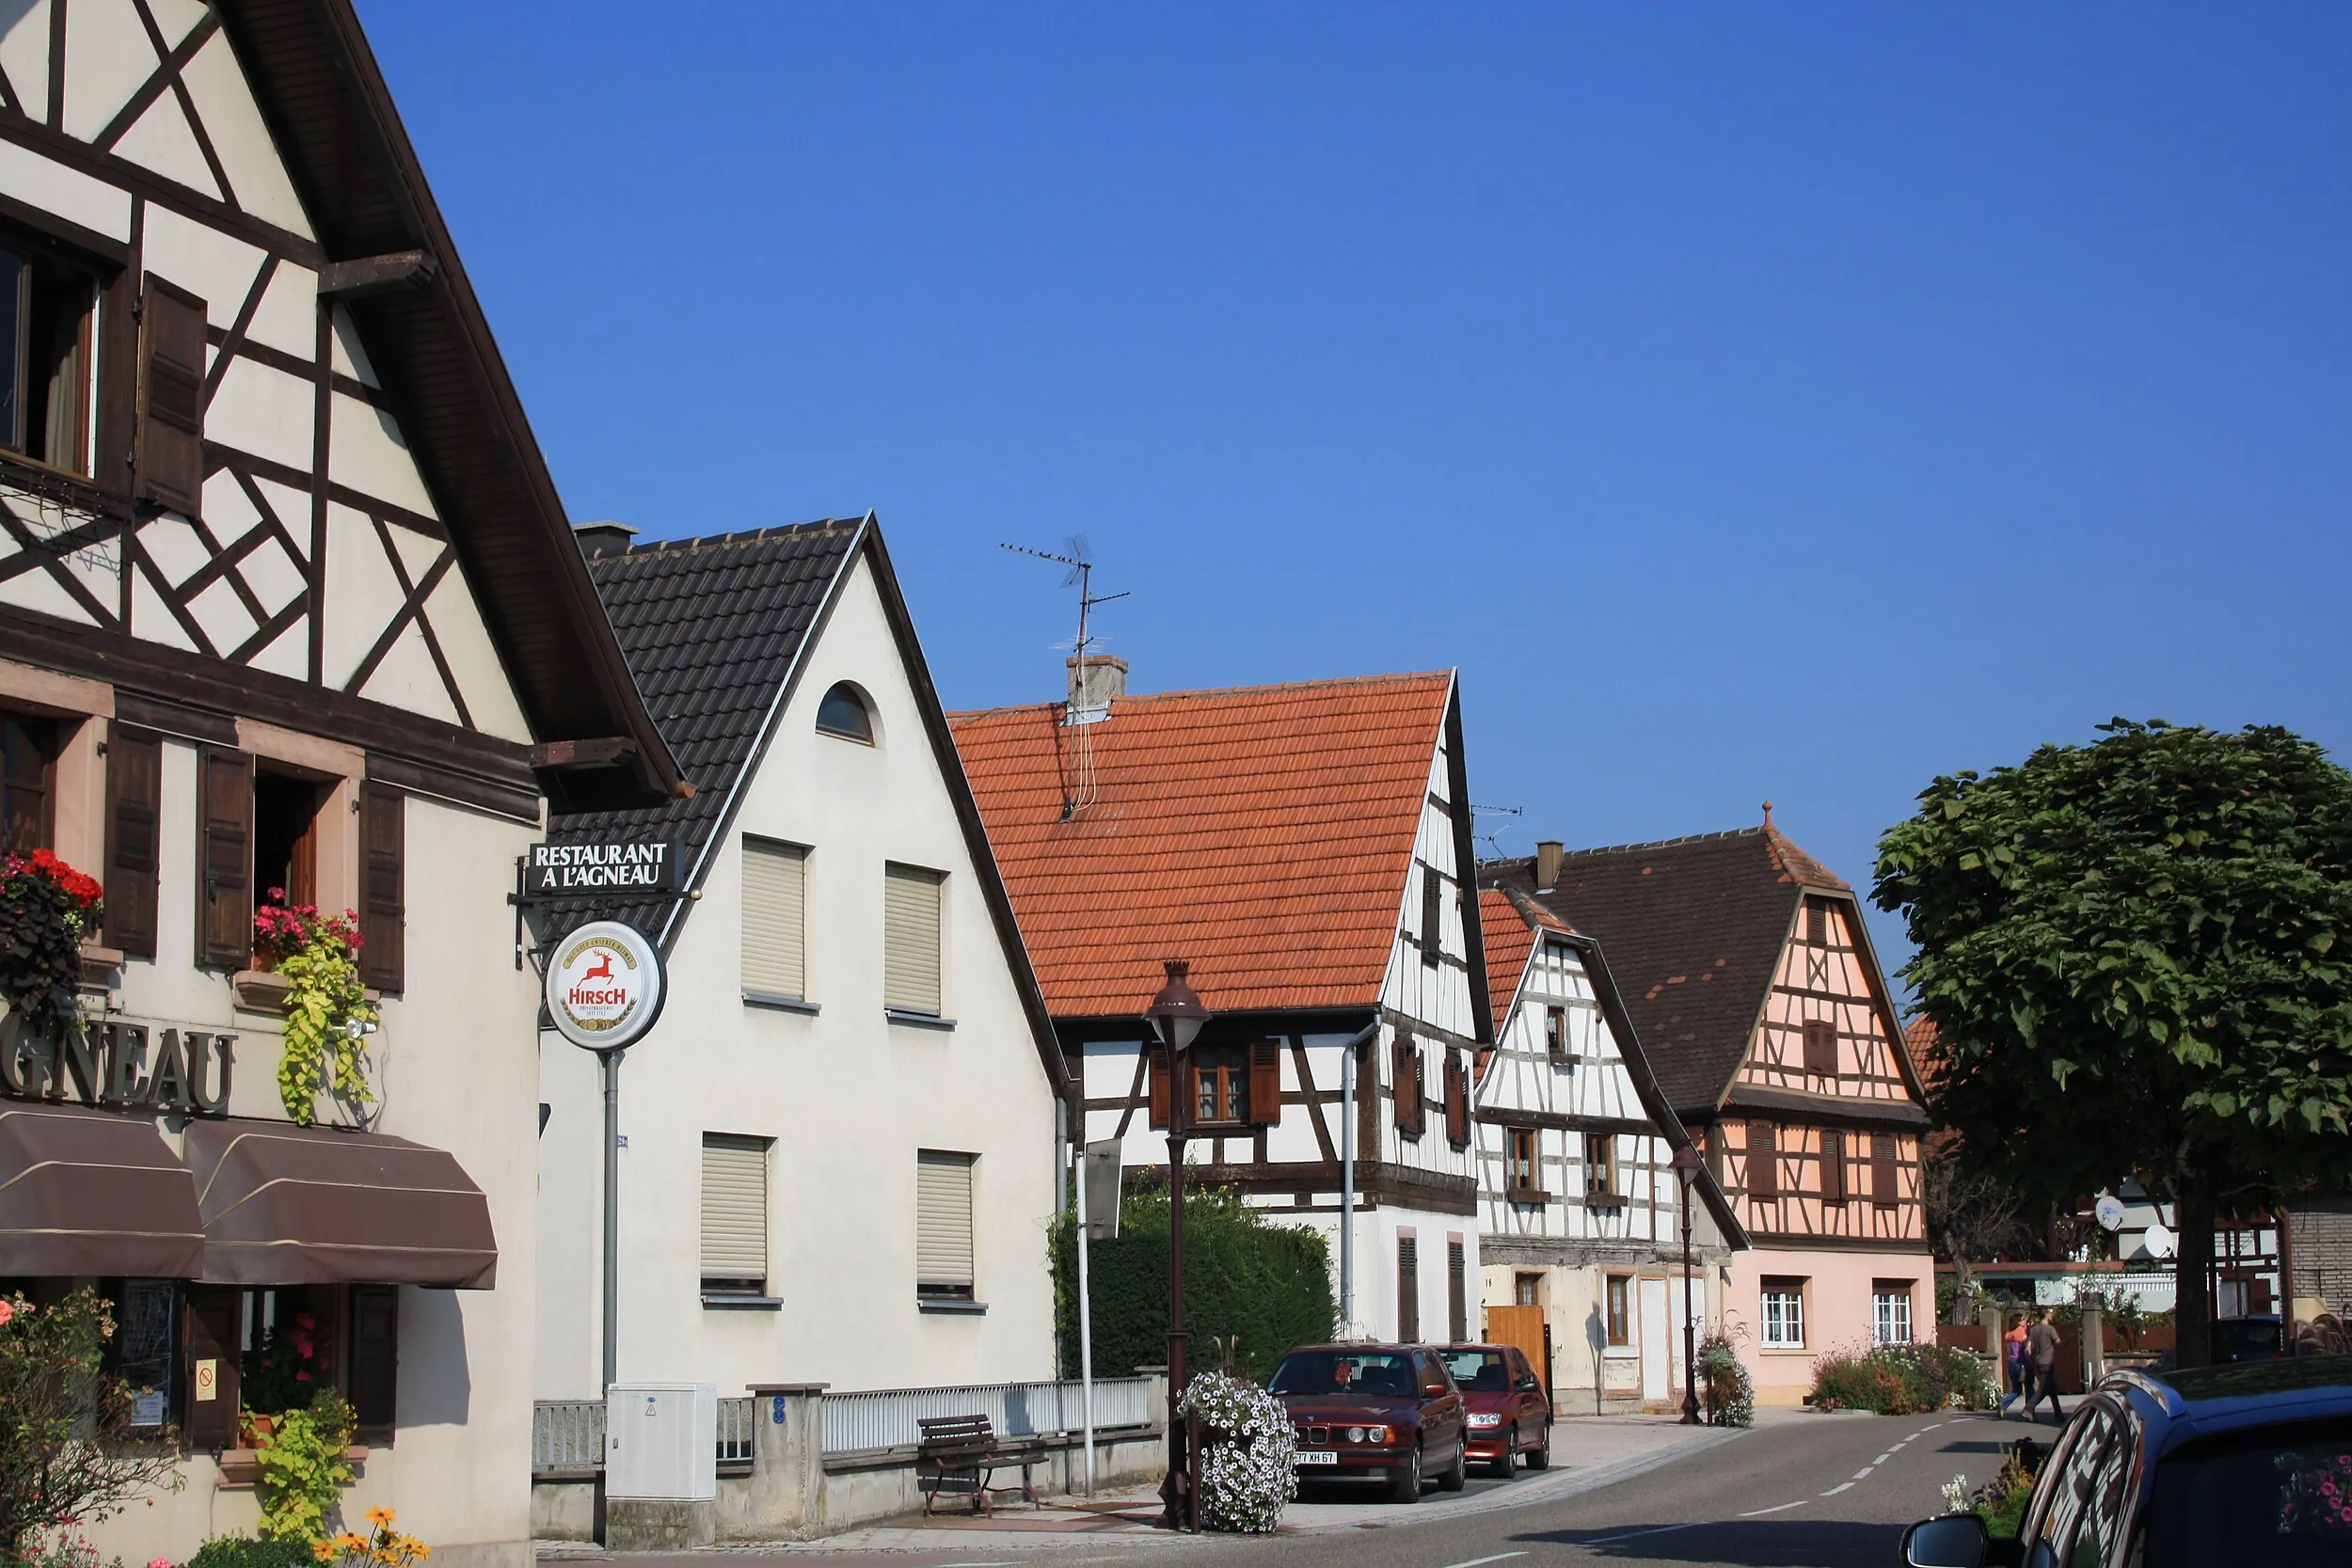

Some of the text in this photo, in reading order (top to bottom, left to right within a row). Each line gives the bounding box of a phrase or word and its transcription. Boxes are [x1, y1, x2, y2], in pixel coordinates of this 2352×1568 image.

[535, 843, 667, 866] RESTAURANT
[541, 864, 660, 888] A L'AGNEAU
[0, 1010, 239, 1111] GNEAU
[1309, 1452, 1320, 1463] XH
[1322, 1452, 1333, 1463] 67
